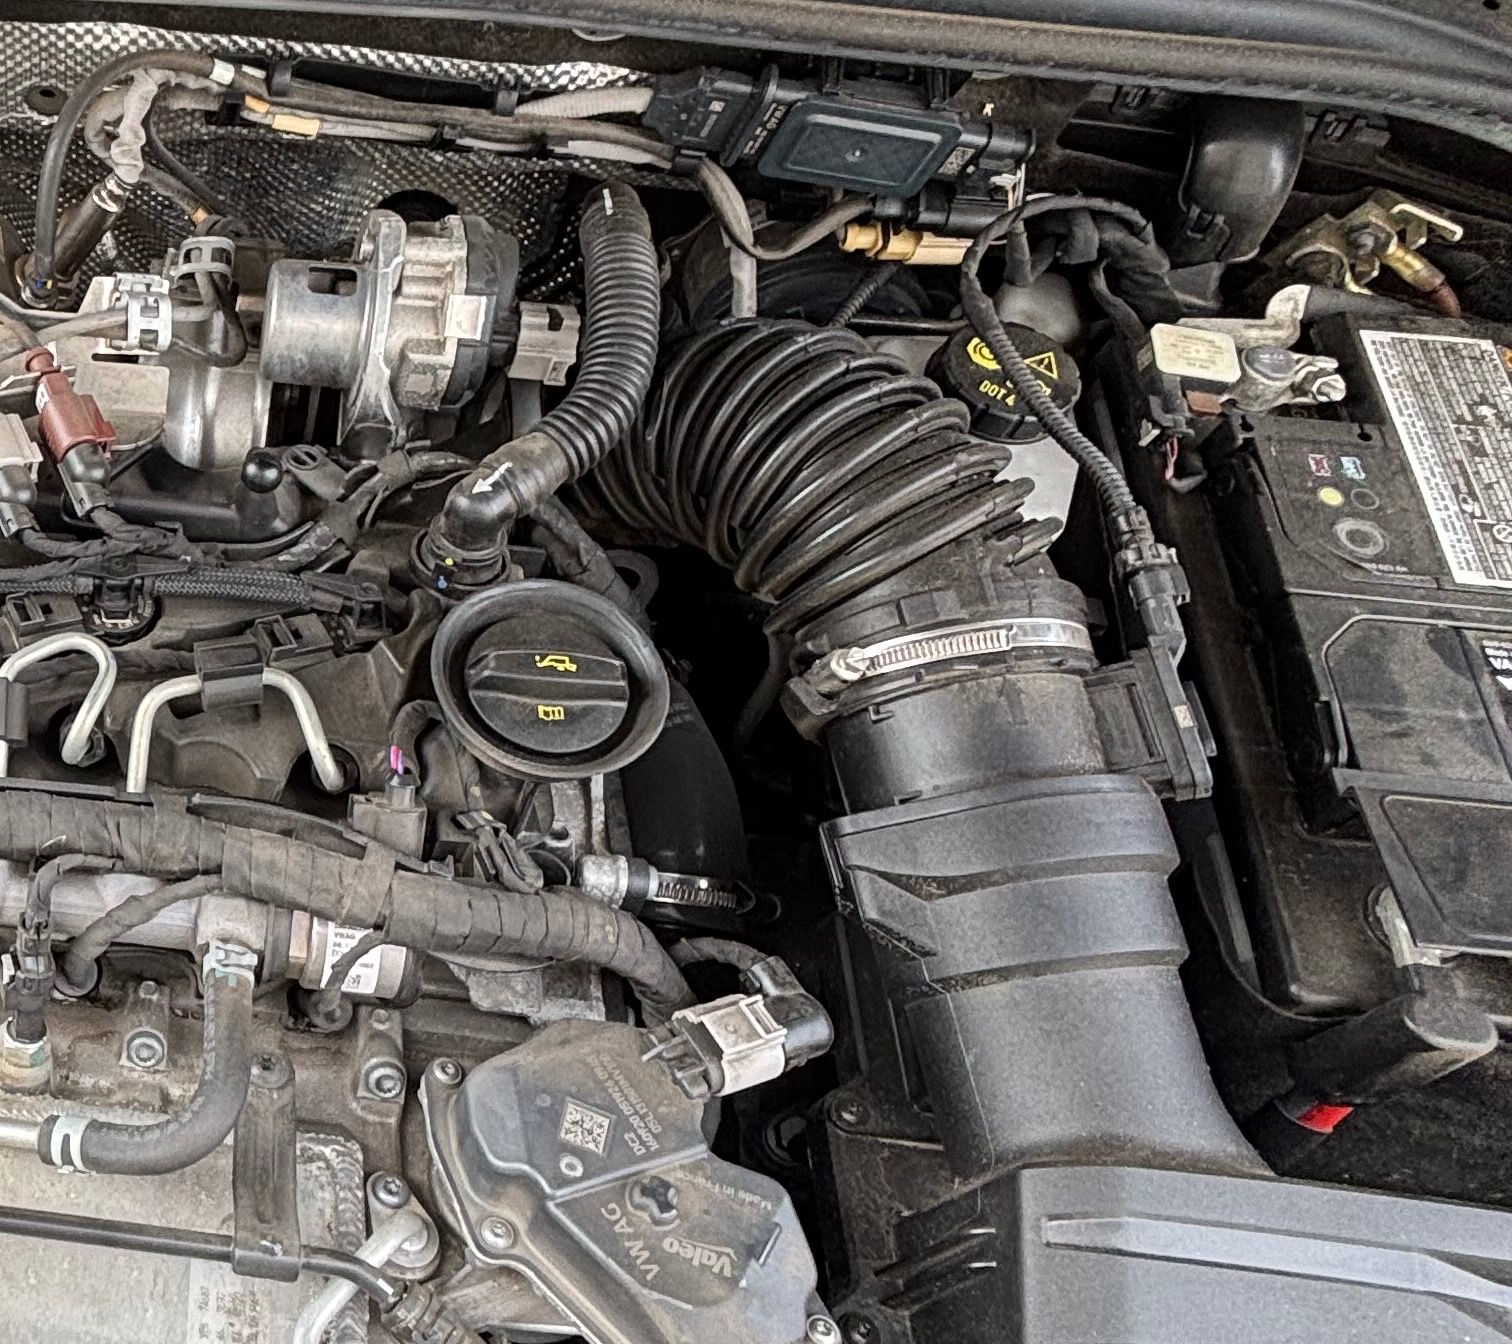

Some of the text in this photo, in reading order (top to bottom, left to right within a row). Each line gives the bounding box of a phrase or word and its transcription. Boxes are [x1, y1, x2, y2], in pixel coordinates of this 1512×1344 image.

[978, 379, 1007, 400] DOT
[624, 1131, 647, 1156] DC2
[600, 1202, 660, 1281] VW AG
[662, 1236, 732, 1278] Valeo
